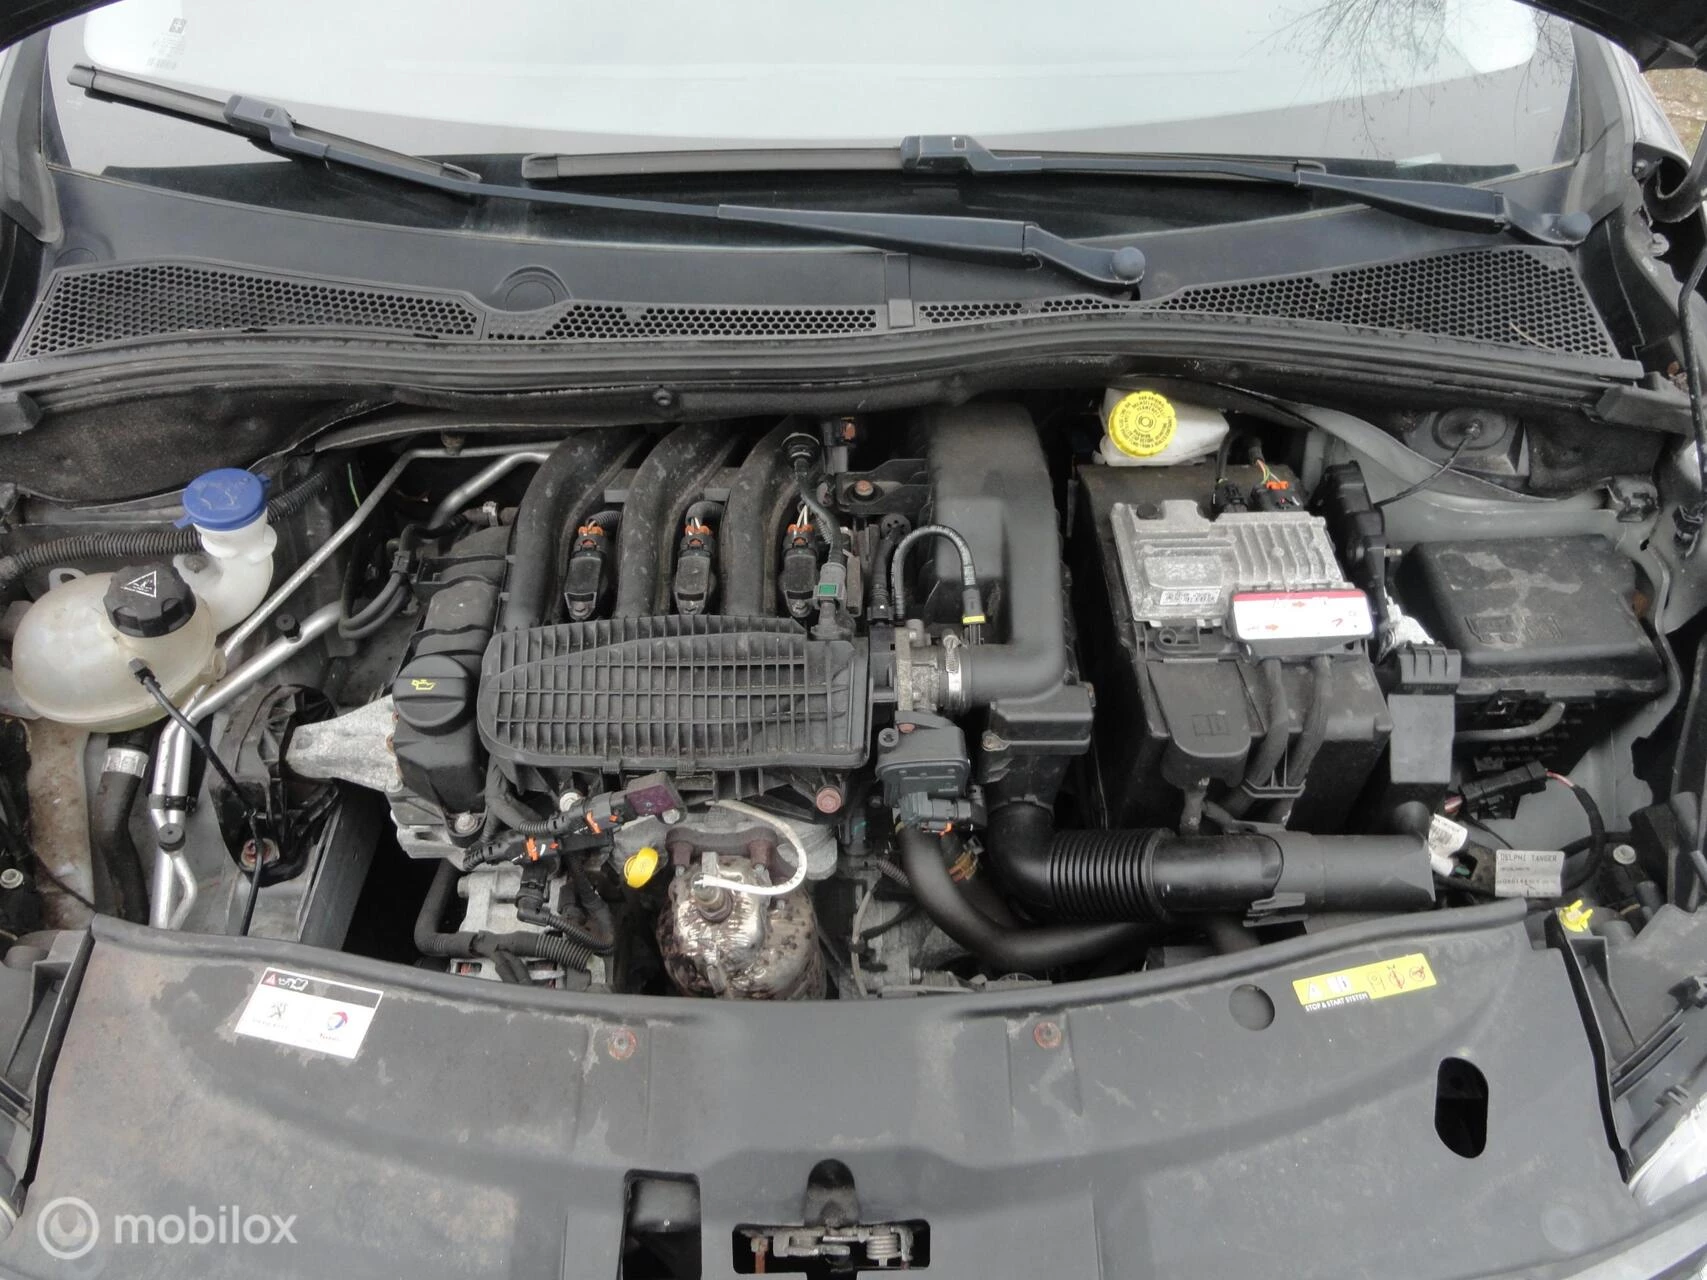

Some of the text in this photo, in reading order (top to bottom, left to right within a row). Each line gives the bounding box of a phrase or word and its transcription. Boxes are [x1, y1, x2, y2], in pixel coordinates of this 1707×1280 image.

[1305, 1002, 1321, 1012] STOP
[1327, 997, 1345, 1008] START
[1345, 992, 1369, 1003] SYSTEM
